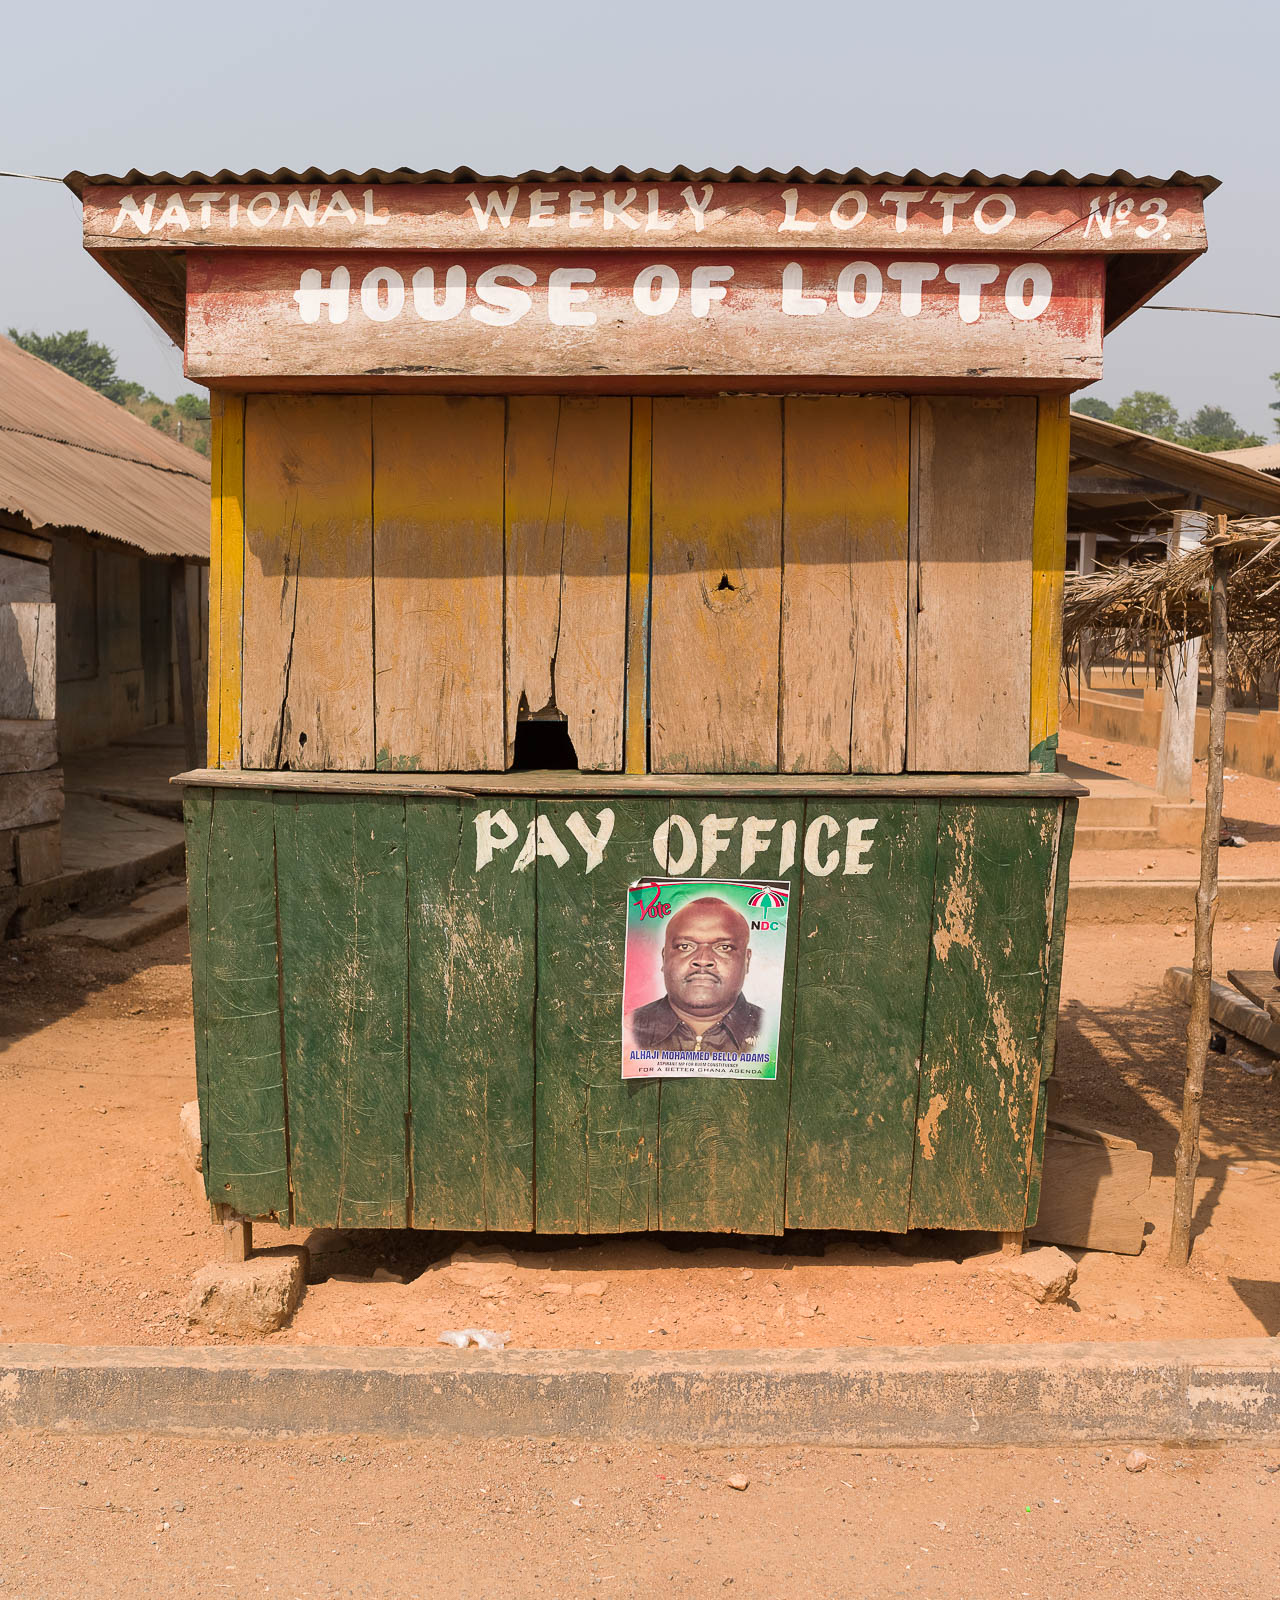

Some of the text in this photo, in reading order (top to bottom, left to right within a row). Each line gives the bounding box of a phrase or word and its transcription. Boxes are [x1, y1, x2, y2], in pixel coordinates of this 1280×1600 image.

[111, 188, 390, 234] NATIONAL
[465, 183, 714, 231] WEEKLY
[778, 187, 1017, 235] LOTTO
[293, 261, 1053, 327] HOUSE OF LOTTO
[473, 807, 879, 877] PAY OFFICE
[633, 882, 672, 921] Vote
[751, 920, 779, 931] NDC
[629, 1050, 770, 1063] ALHAJI MOHAMMED BELLO ADAMS
